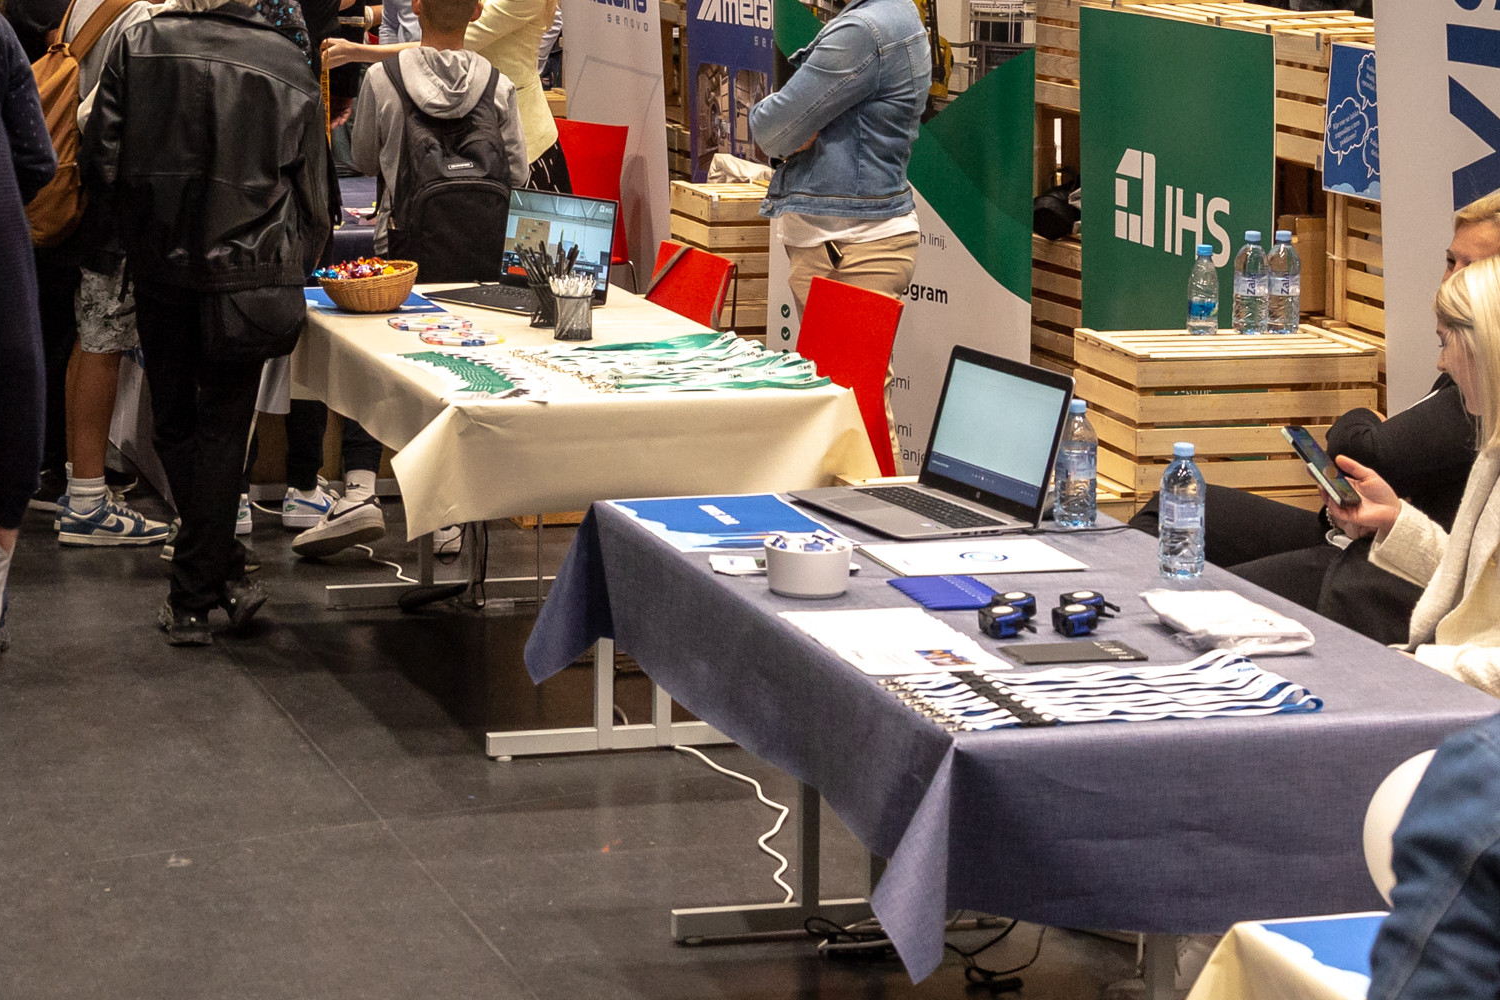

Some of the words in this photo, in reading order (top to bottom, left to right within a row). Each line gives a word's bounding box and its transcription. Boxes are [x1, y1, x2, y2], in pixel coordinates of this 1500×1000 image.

[607, 12, 649, 33] senovo
[1164, 184, 1231, 268] IHS
[902, 283, 948, 304] ogram
